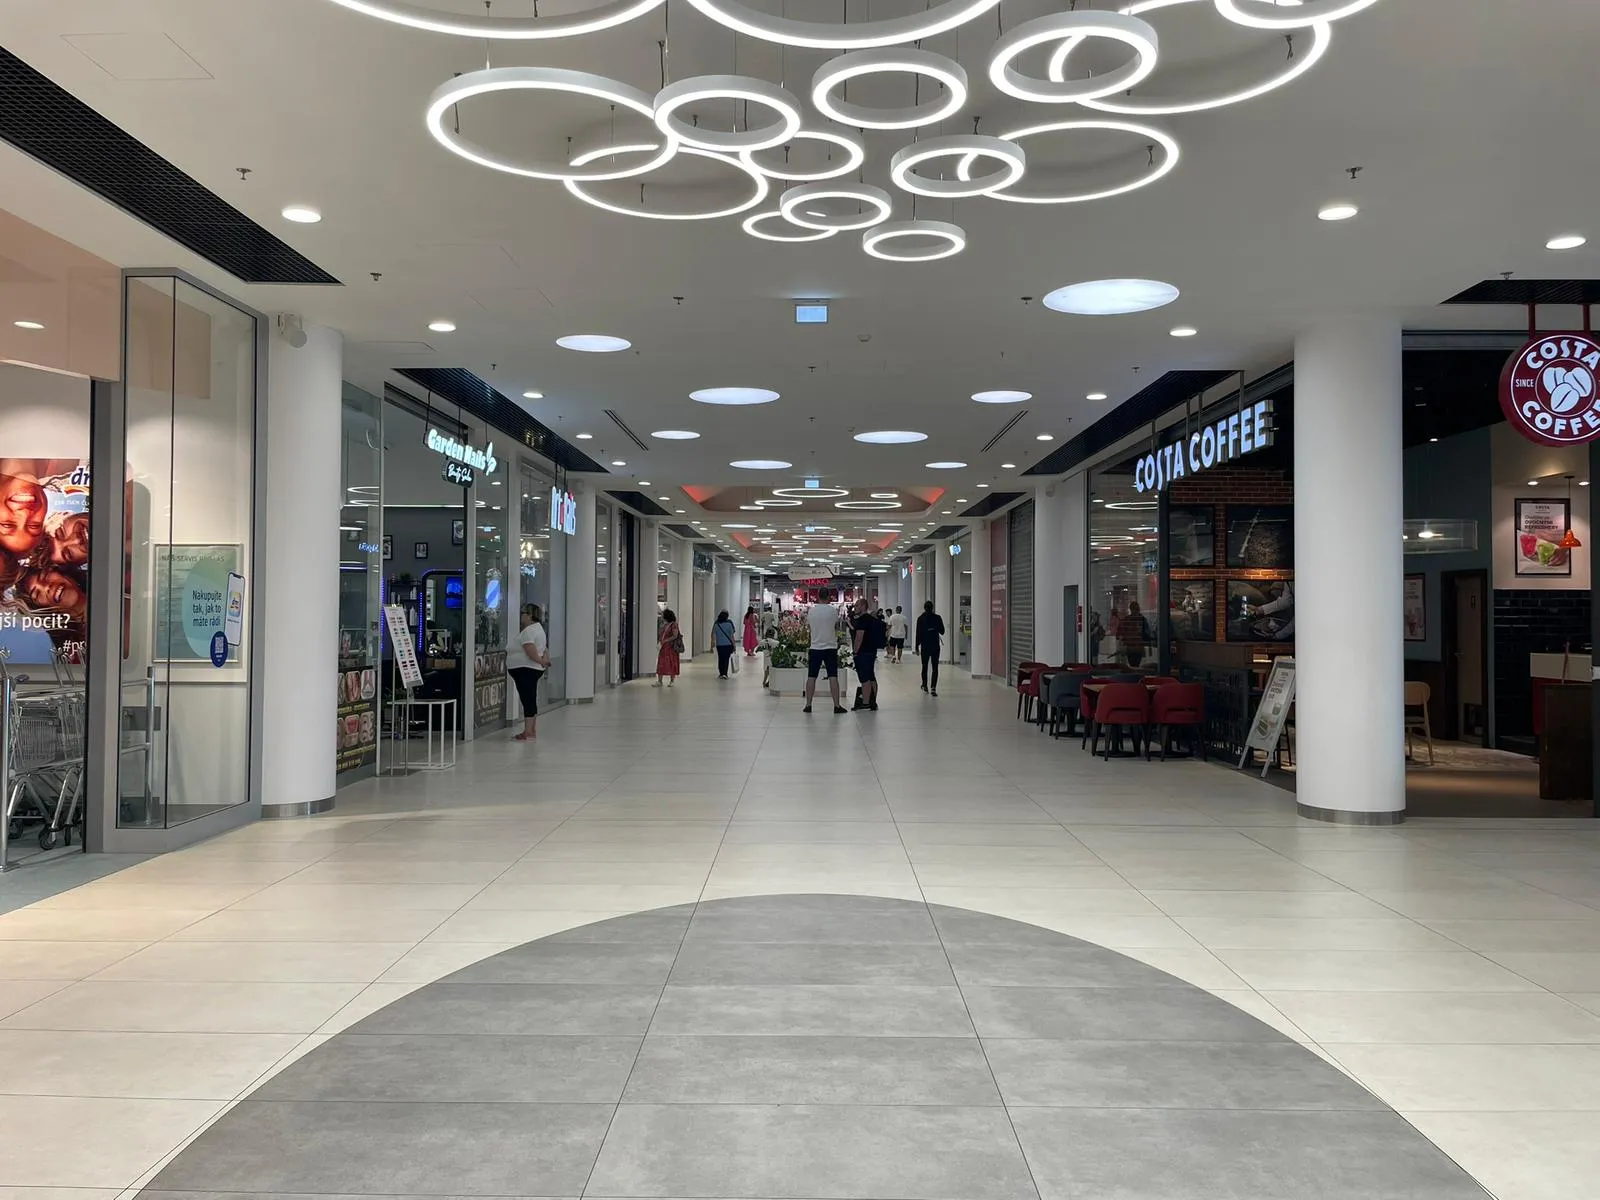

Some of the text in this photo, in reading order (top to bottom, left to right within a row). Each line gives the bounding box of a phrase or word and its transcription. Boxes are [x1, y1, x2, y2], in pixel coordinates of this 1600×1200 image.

[1526, 339, 1600, 370] COSTA
[1515, 379, 1535, 388] SINCE
[428, 428, 487, 471] Garden Nails
[1135, 399, 1268, 493] COSTA COFFEE
[192, 590, 222, 603] Nakupujte
[205, 604, 214, 615] jak
[215, 604, 222, 614] to
[22, 613, 71, 632] pocit?
